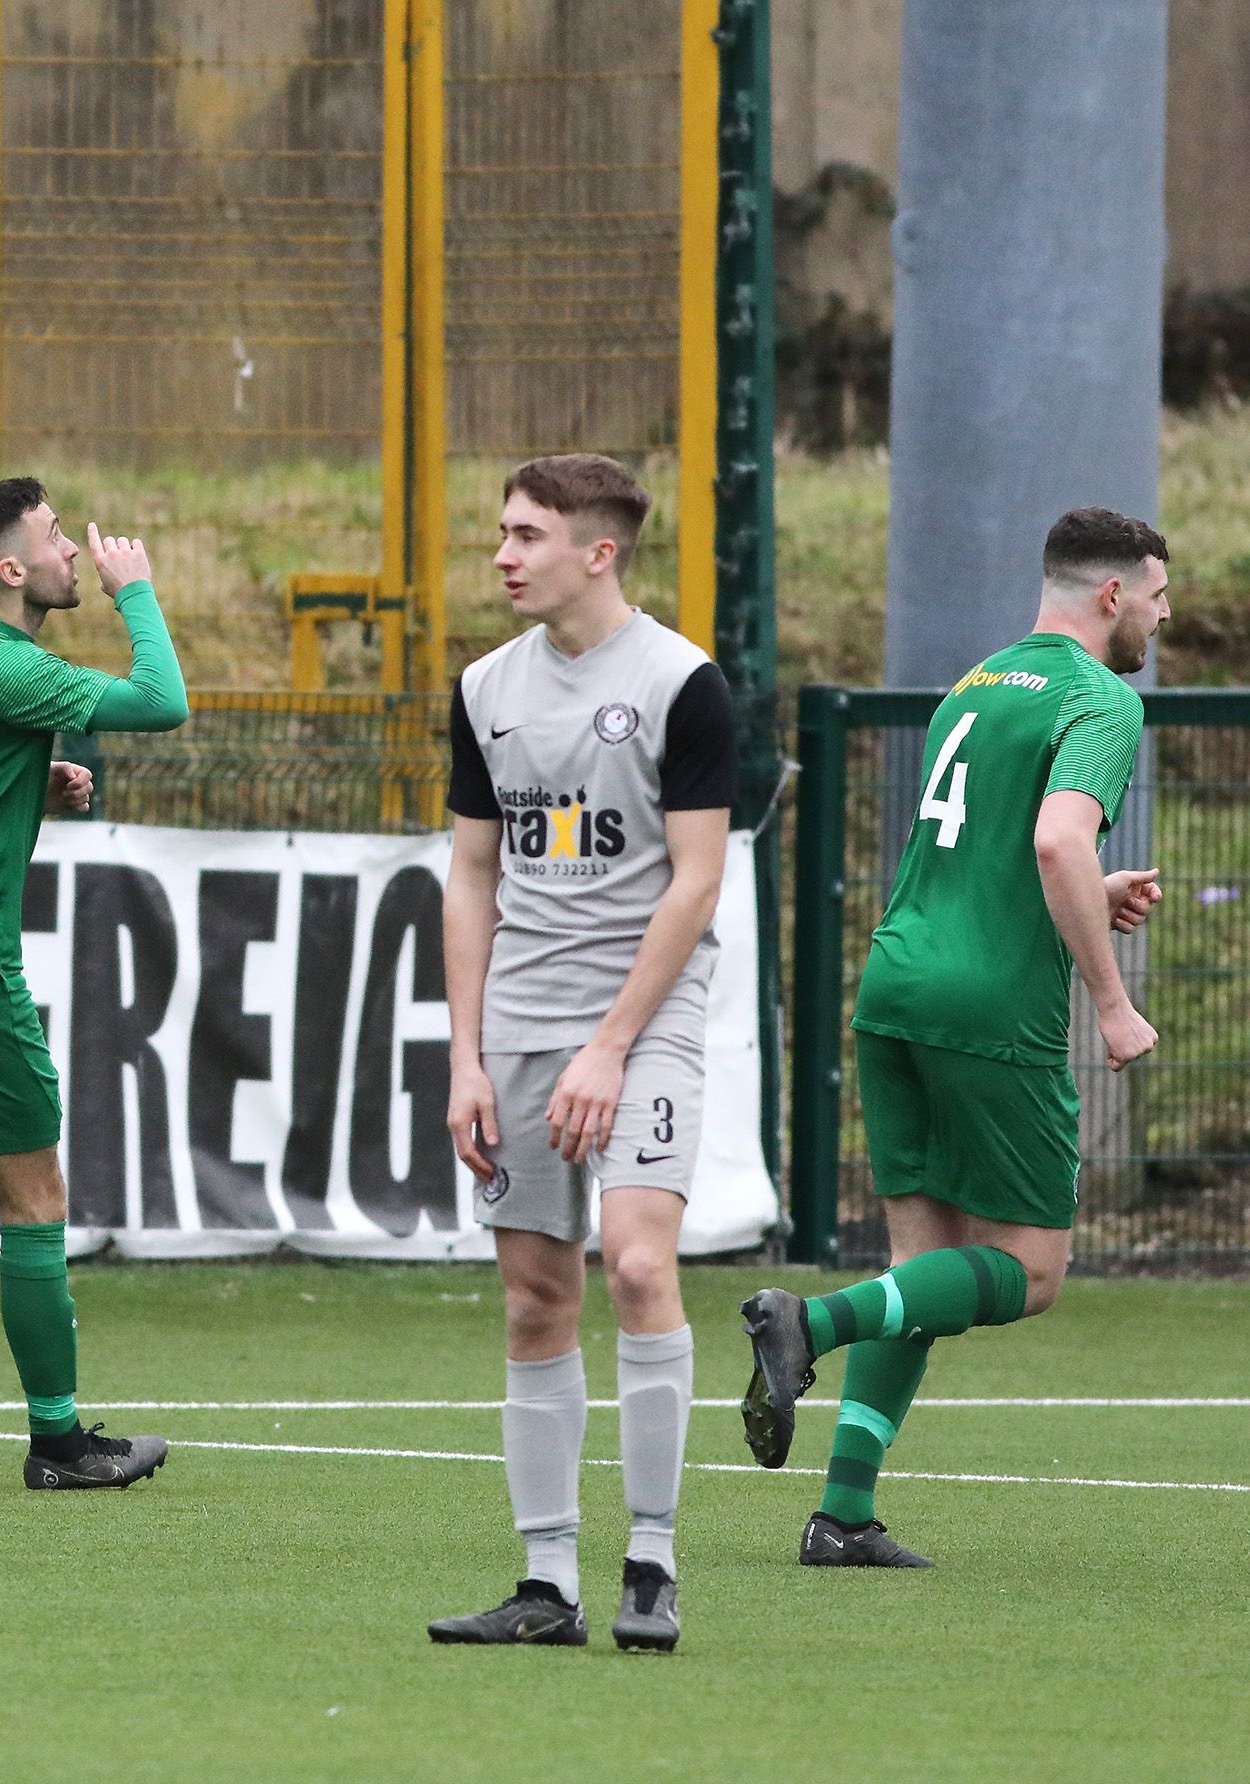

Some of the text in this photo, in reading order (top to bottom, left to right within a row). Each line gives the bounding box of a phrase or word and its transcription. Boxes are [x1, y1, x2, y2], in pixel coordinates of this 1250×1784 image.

[918, 712, 979, 849] 4
[552, 861, 610, 877] 732211
[652, 1096, 675, 1144] 3
